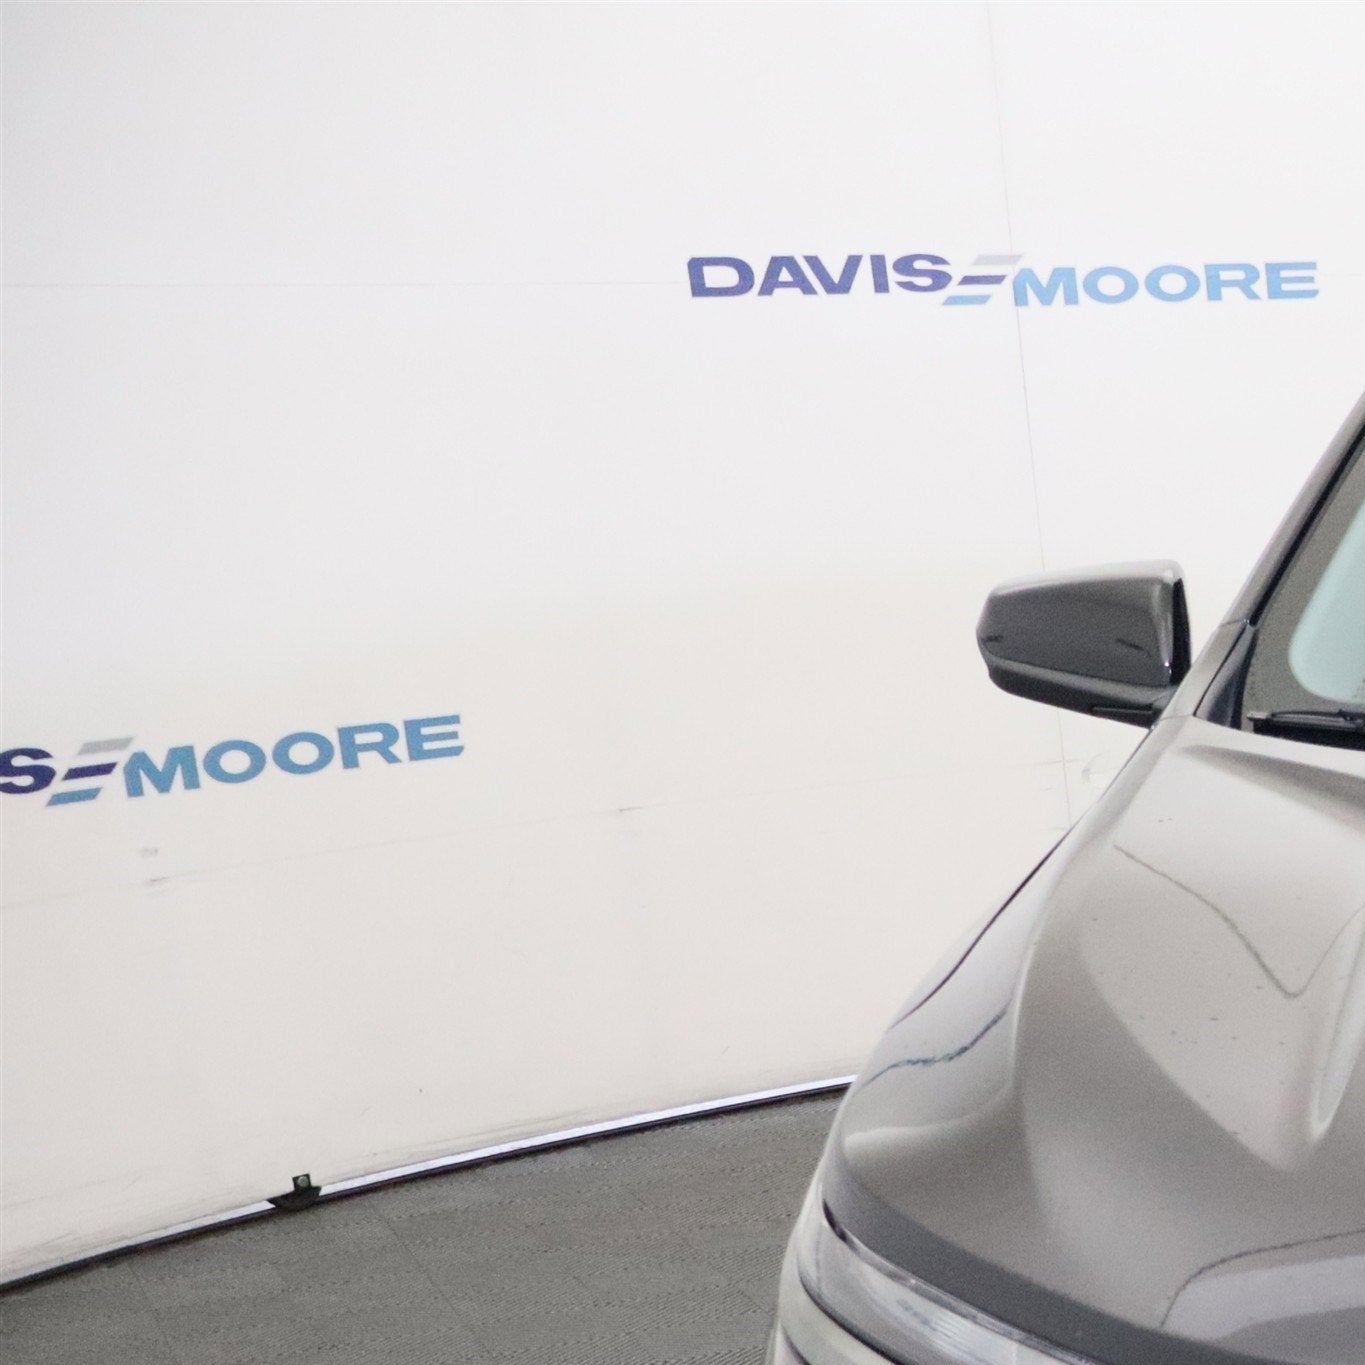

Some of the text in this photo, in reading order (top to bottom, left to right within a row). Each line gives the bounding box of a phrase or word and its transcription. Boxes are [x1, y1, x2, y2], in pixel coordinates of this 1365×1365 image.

[686, 253, 1320, 308] DAVIS MOORE
[122, 713, 465, 798] MOORE
